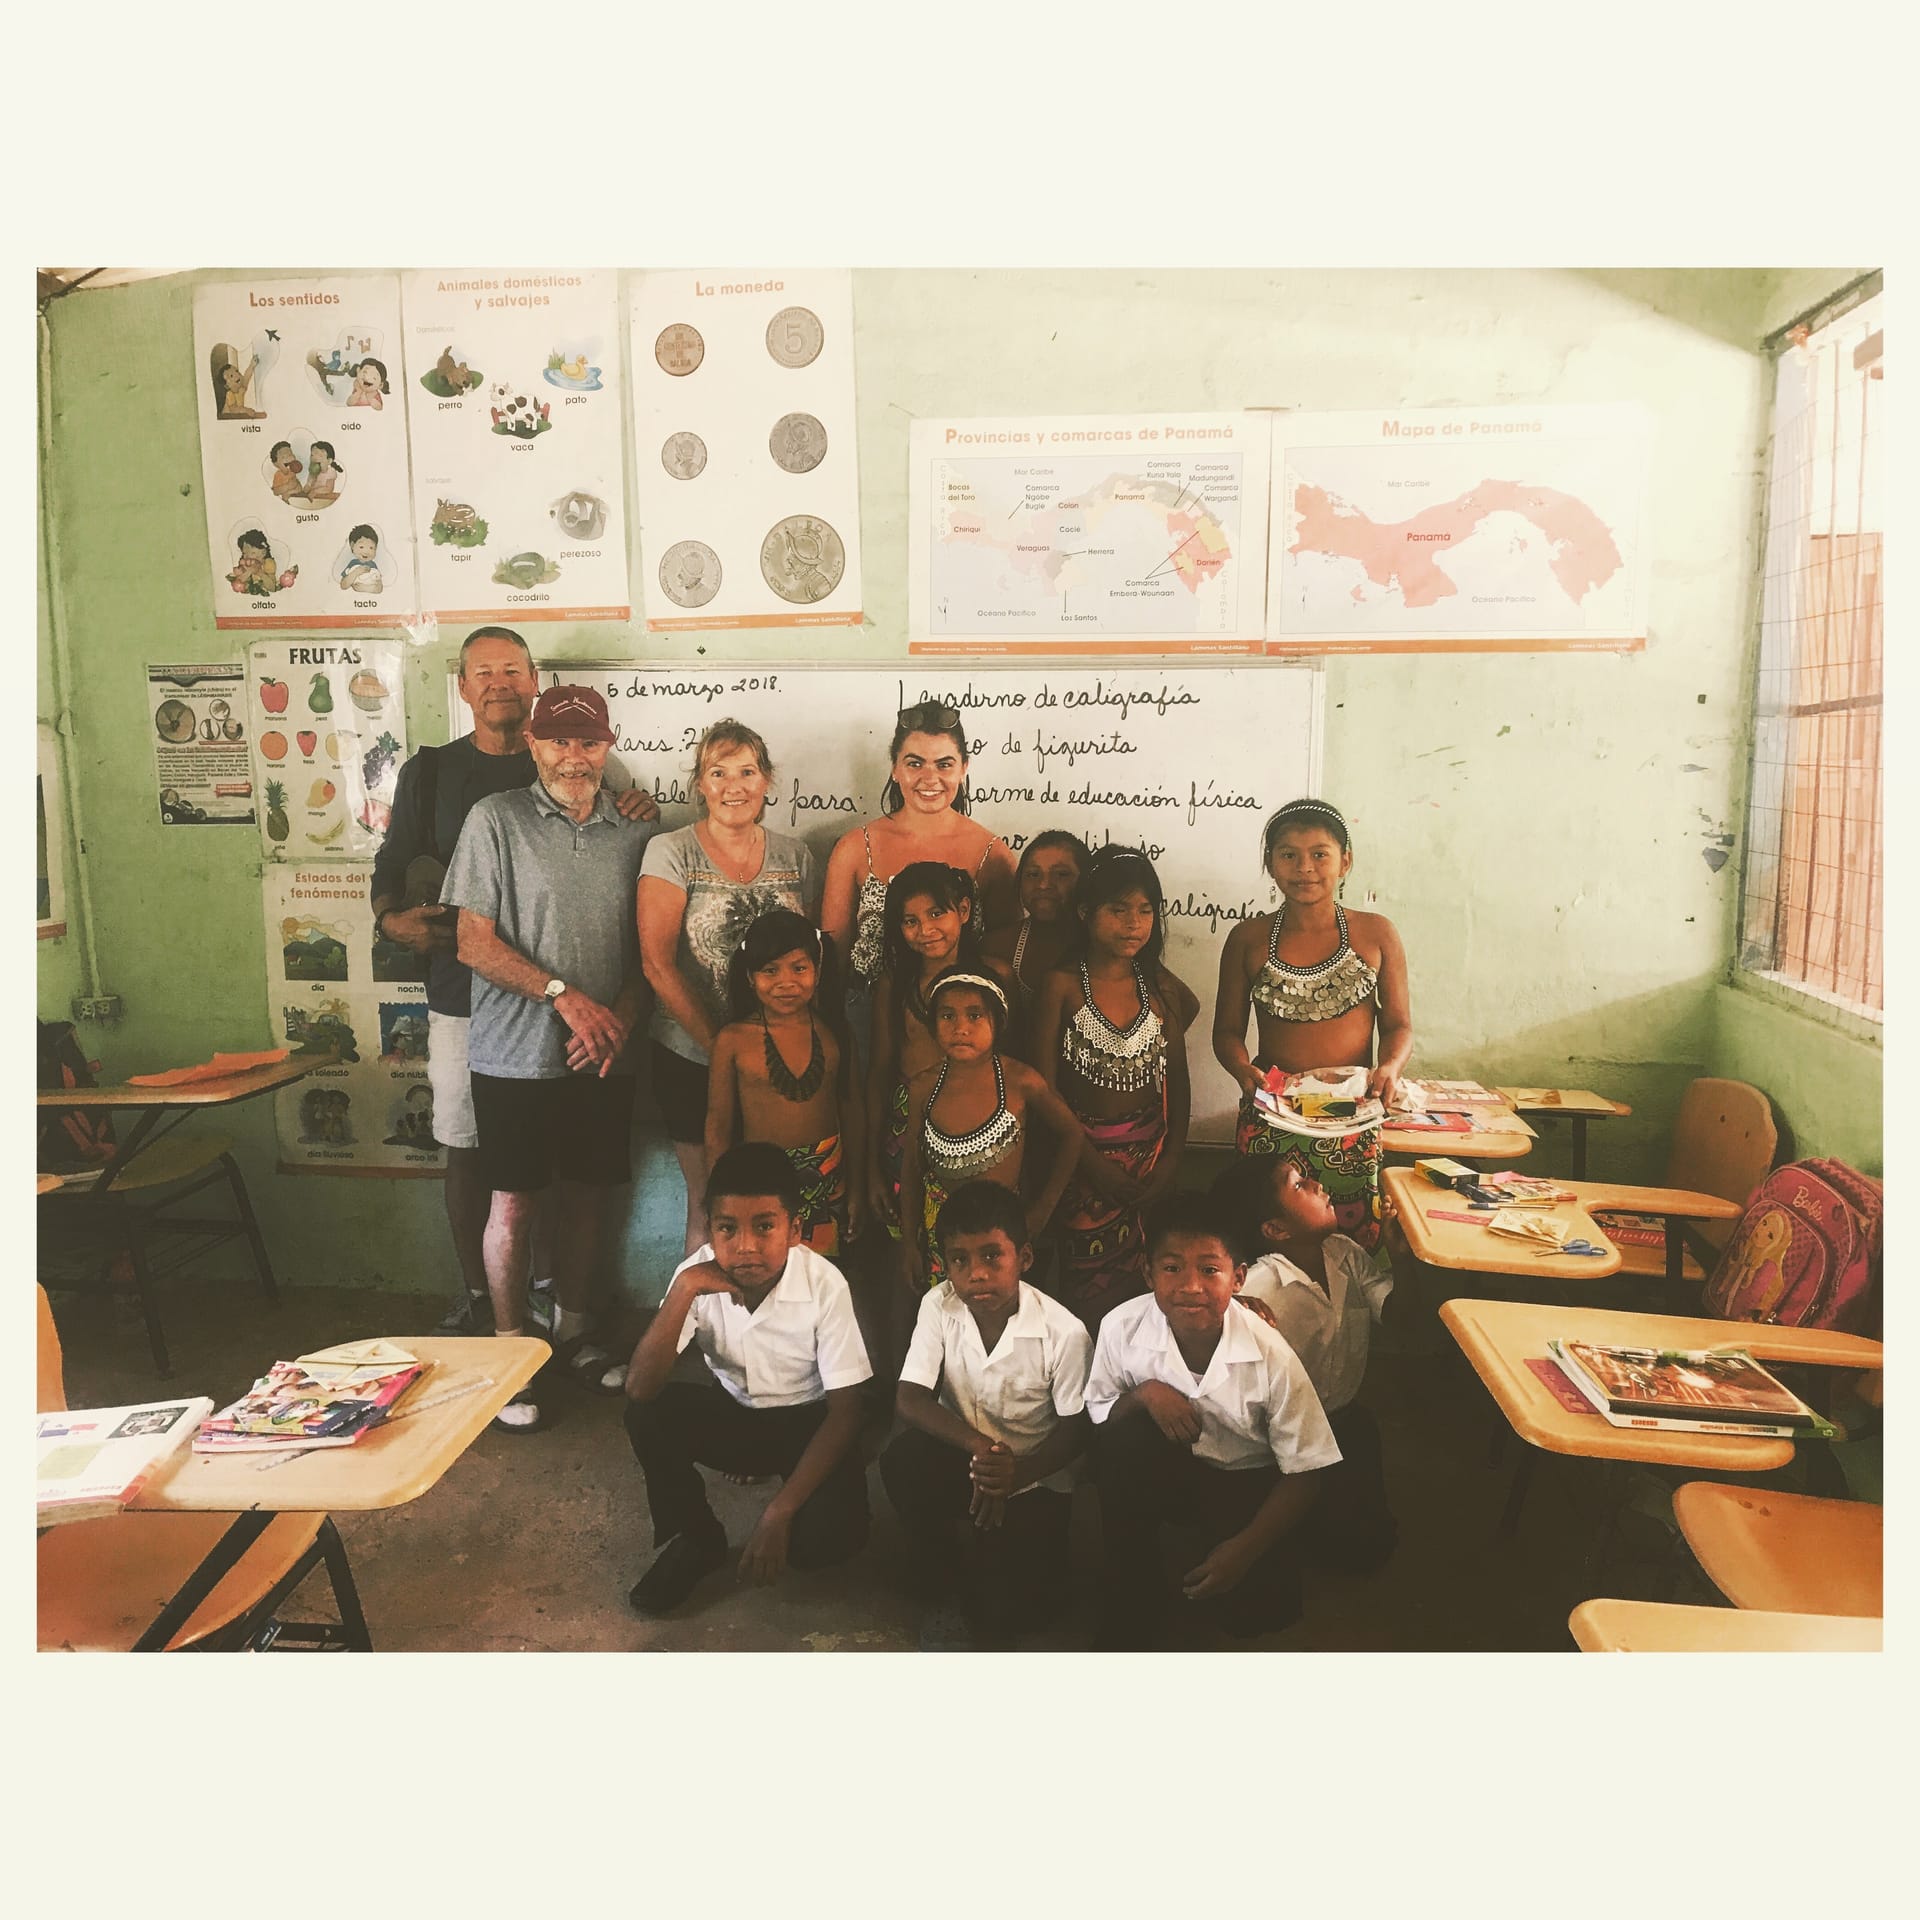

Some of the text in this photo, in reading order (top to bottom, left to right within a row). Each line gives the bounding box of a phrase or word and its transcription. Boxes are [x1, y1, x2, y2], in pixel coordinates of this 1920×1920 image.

[437, 275, 582, 292] Animales domésticos
[696, 280, 785, 297] La moneda
[250, 292, 340, 308] Los sentidos
[474, 294, 550, 310] y salvajes
[438, 400, 463, 412] perro
[565, 395, 587, 407] pato
[241, 424, 262, 434] vista
[1382, 422, 1435, 438] Mapa
[1442, 422, 1463, 435] de
[945, 426, 1234, 445] Provincias y comarcas de Panamá
[510, 443, 534, 452] vaca
[1025, 484, 1060, 492] Comarca
[1204, 484, 1239, 492] Comarca
[295, 513, 320, 524] gusto
[560, 548, 602, 560] perezoso
[1088, 548, 1115, 556] Herrera
[450, 553, 472, 565] tapir
[506, 592, 550, 602] cocodrilo
[251, 601, 276, 610] olfato
[354, 600, 378, 608] tacto
[1061, 614, 1098, 622] Los Santos
[290, 648, 362, 664] FRUTAS
[626, 677, 648, 698] de
[653, 682, 724, 703] marzo
[731, 676, 782, 693] 2018.
[919, 682, 1026, 709] cuaderno
[1034, 683, 1058, 708] de
[1063, 681, 1200, 720] caligrafía
[1002, 732, 1022, 755] de
[1032, 729, 1138, 774] figurita
[1040, 781, 1060, 804] de
[1068, 781, 1180, 809] educación
[1187, 779, 1263, 826] física
[296, 872, 366, 884] Estados del
[290, 886, 366, 900] fenómenos
[398, 984, 425, 994] noche
[405, 1154, 425, 1162] arco
